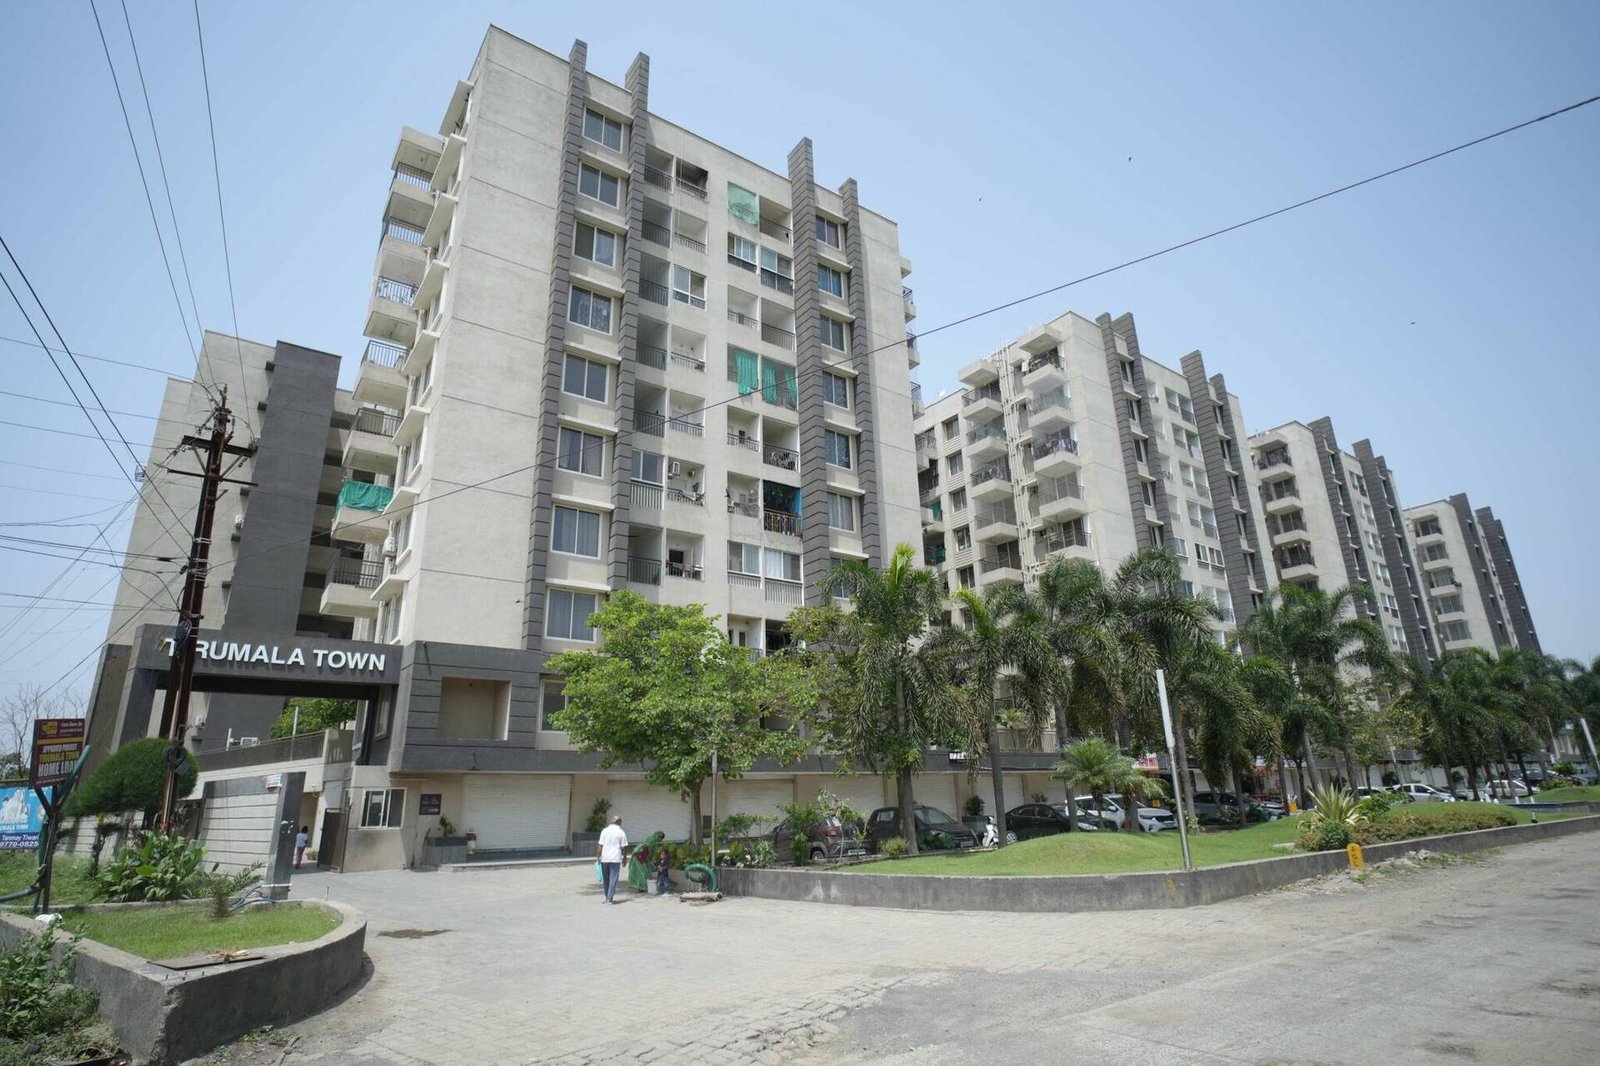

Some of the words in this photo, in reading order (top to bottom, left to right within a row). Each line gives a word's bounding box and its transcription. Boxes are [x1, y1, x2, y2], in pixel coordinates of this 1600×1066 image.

[164, 637, 305, 666] TRUMALA
[313, 649, 386, 672] TOWN
[38, 761, 60, 777] HOME
